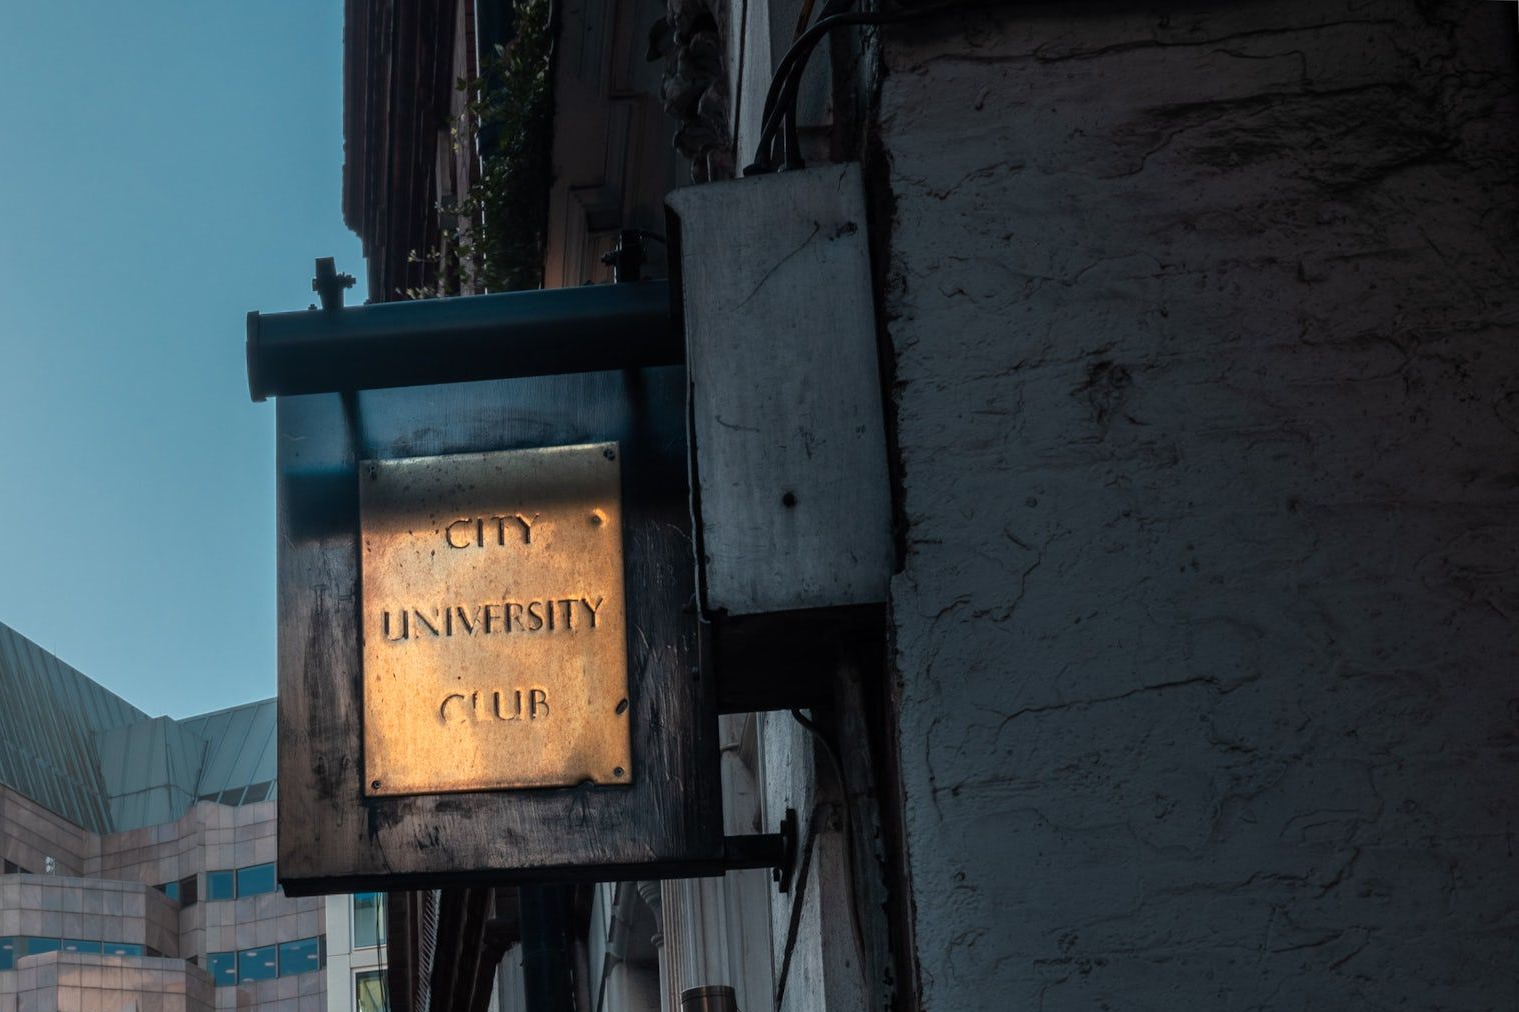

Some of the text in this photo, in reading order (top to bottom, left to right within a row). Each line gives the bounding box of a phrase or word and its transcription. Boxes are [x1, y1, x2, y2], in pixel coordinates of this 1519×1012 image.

[445, 513, 540, 549] CITY
[383, 597, 604, 642] UNIVERSITY
[439, 688, 551, 722] CLUB
